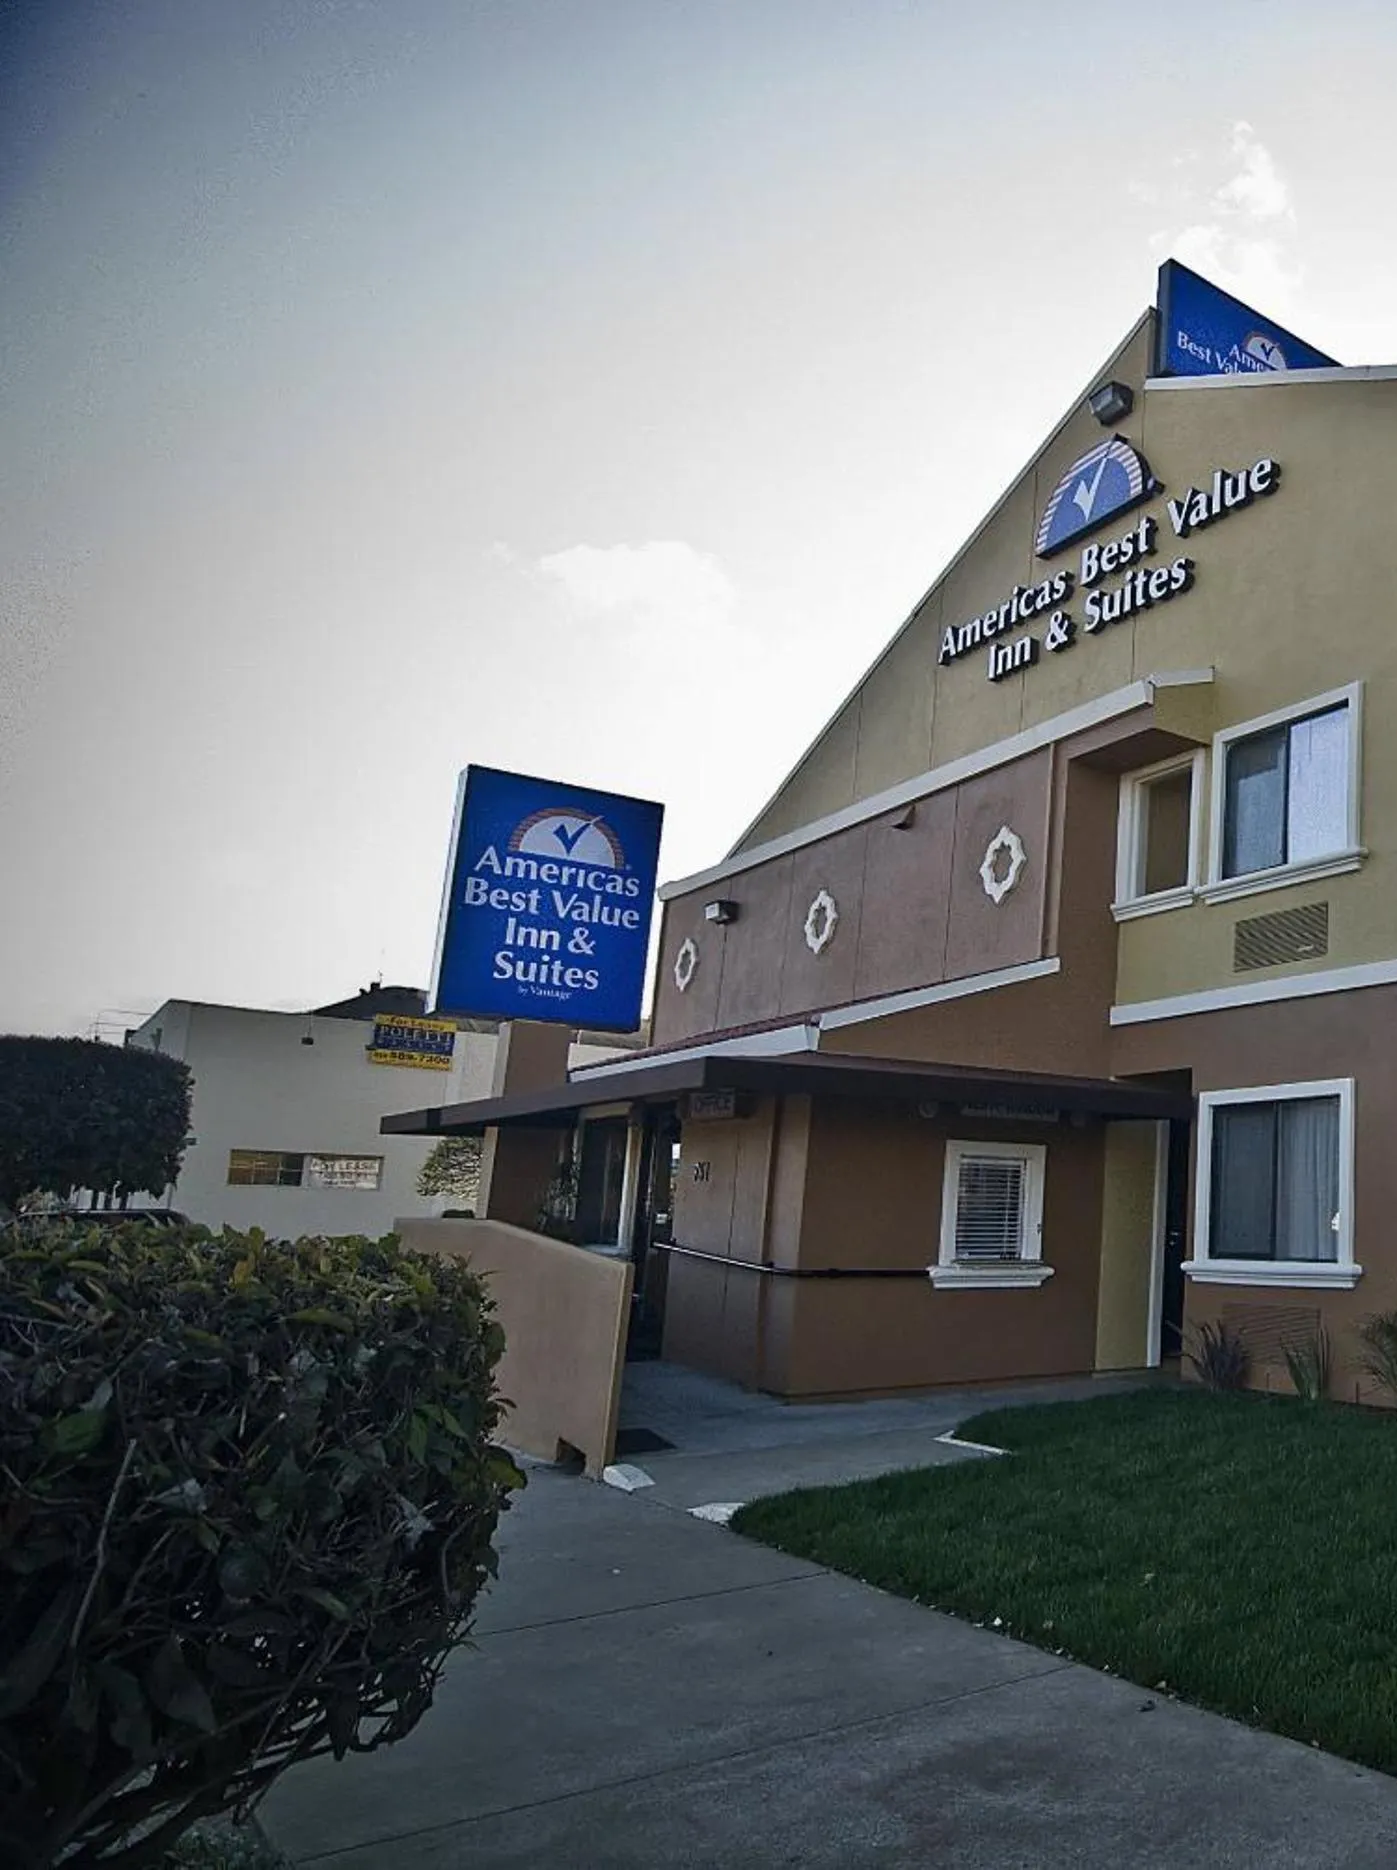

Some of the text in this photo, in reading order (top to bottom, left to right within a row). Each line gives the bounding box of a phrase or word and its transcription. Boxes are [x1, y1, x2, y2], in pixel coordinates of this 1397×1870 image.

[1177, 330, 1211, 362] Best
[938, 458, 1278, 665] Americas Best Value
[987, 557, 1192, 681] Inn & Suites
[474, 845, 641, 897] Americas
[464, 876, 640, 929] Best Value
[504, 917, 597, 956] Inn &
[492, 950, 600, 990] Suites
